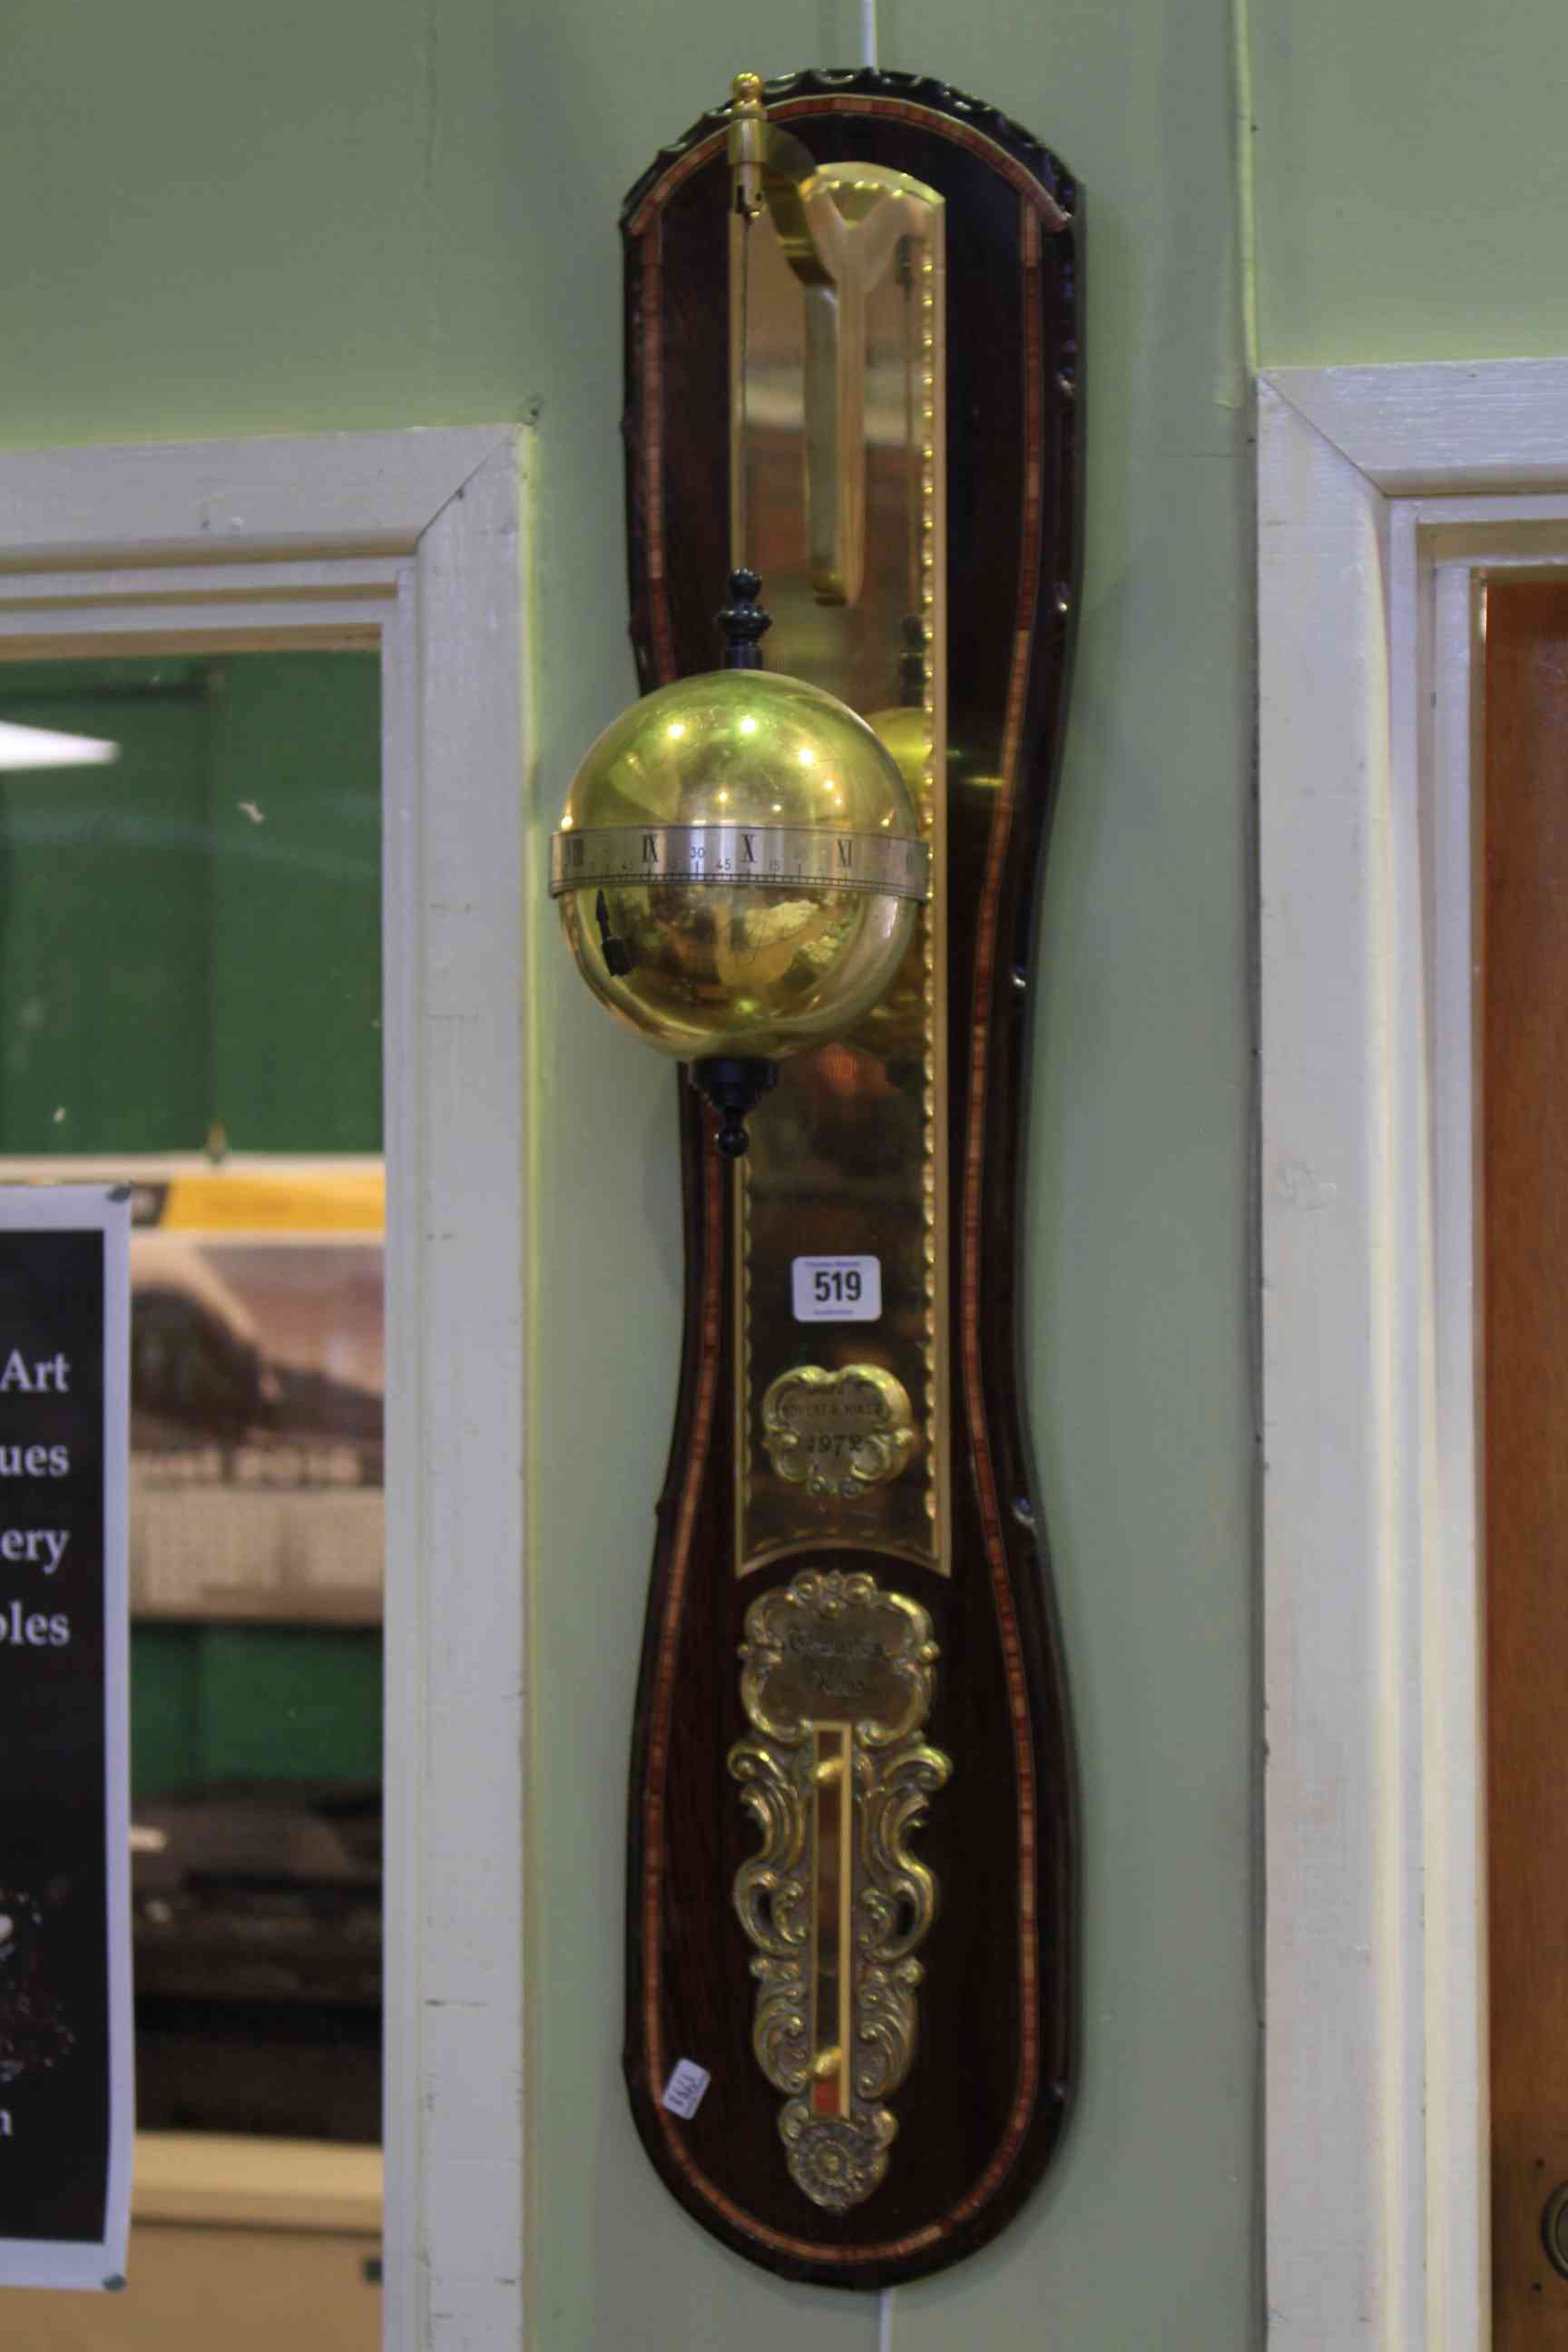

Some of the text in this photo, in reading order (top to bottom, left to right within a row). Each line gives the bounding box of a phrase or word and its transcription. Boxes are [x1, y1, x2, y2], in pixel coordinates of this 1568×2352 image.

[689, 846, 706, 858] 30
[740, 834, 757, 863] X
[715, 858, 731, 871] 45
[815, 1270, 862, 1301] 519
[0, 1348, 71, 1393] Art
[0, 1528, 70, 1575] ery
